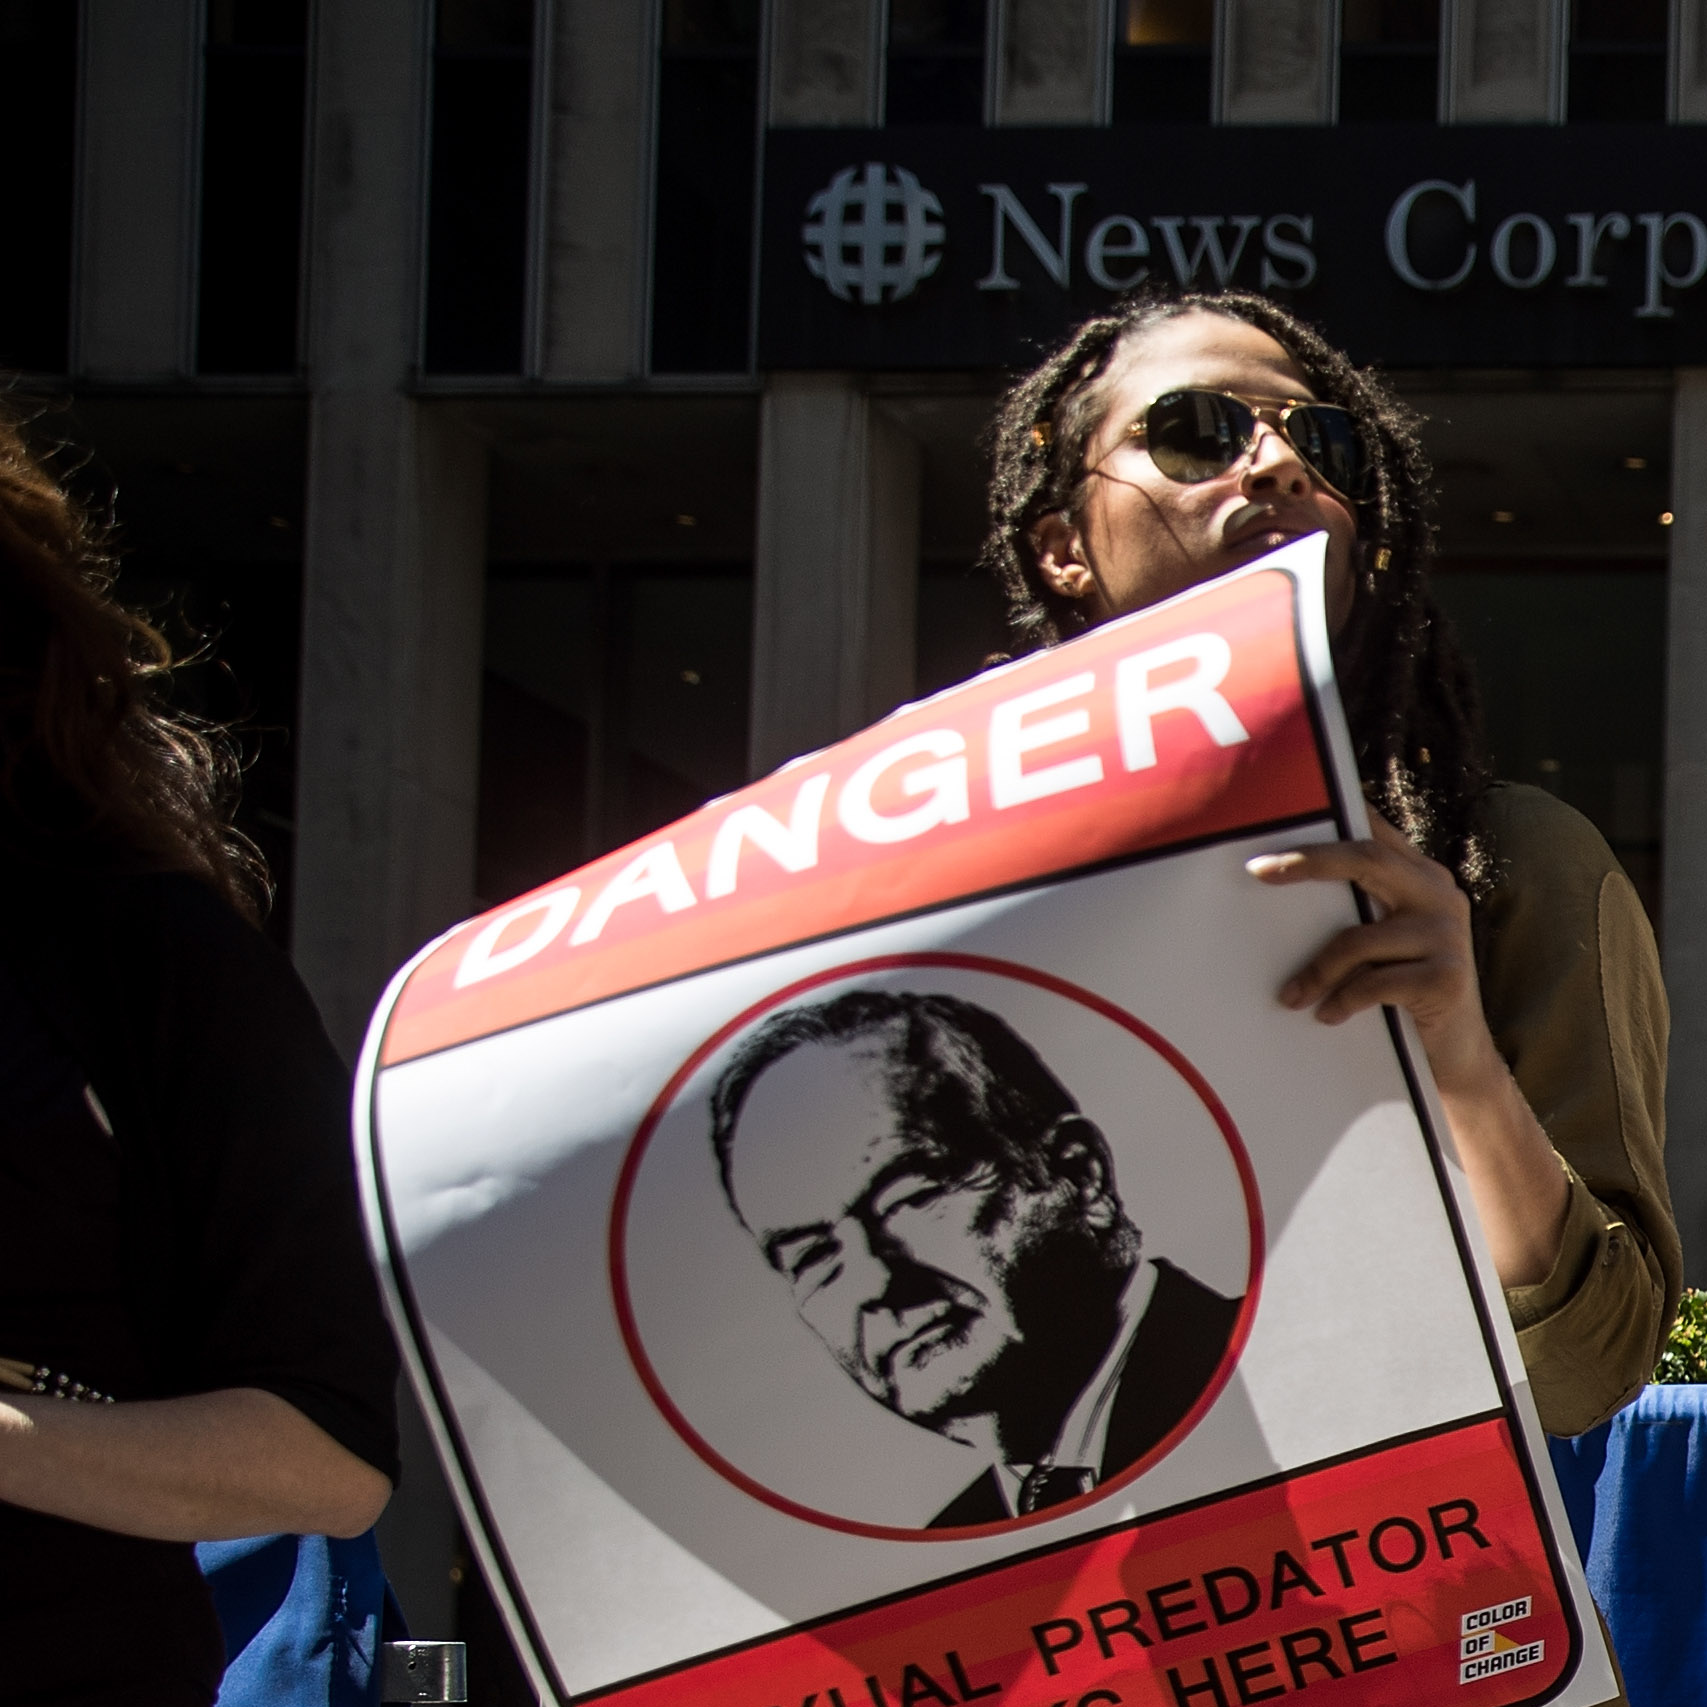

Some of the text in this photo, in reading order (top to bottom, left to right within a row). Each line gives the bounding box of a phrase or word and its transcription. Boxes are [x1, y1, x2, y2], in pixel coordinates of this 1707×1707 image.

[975, 181, 1318, 292] News
[453, 631, 1251, 989] DANGER
[1031, 1496, 1491, 1676] PREDATOR
[1466, 1601, 1527, 1630] COLOR
[1465, 1635, 1489, 1654] OF
[1465, 1645, 1539, 1679] CHANGE
